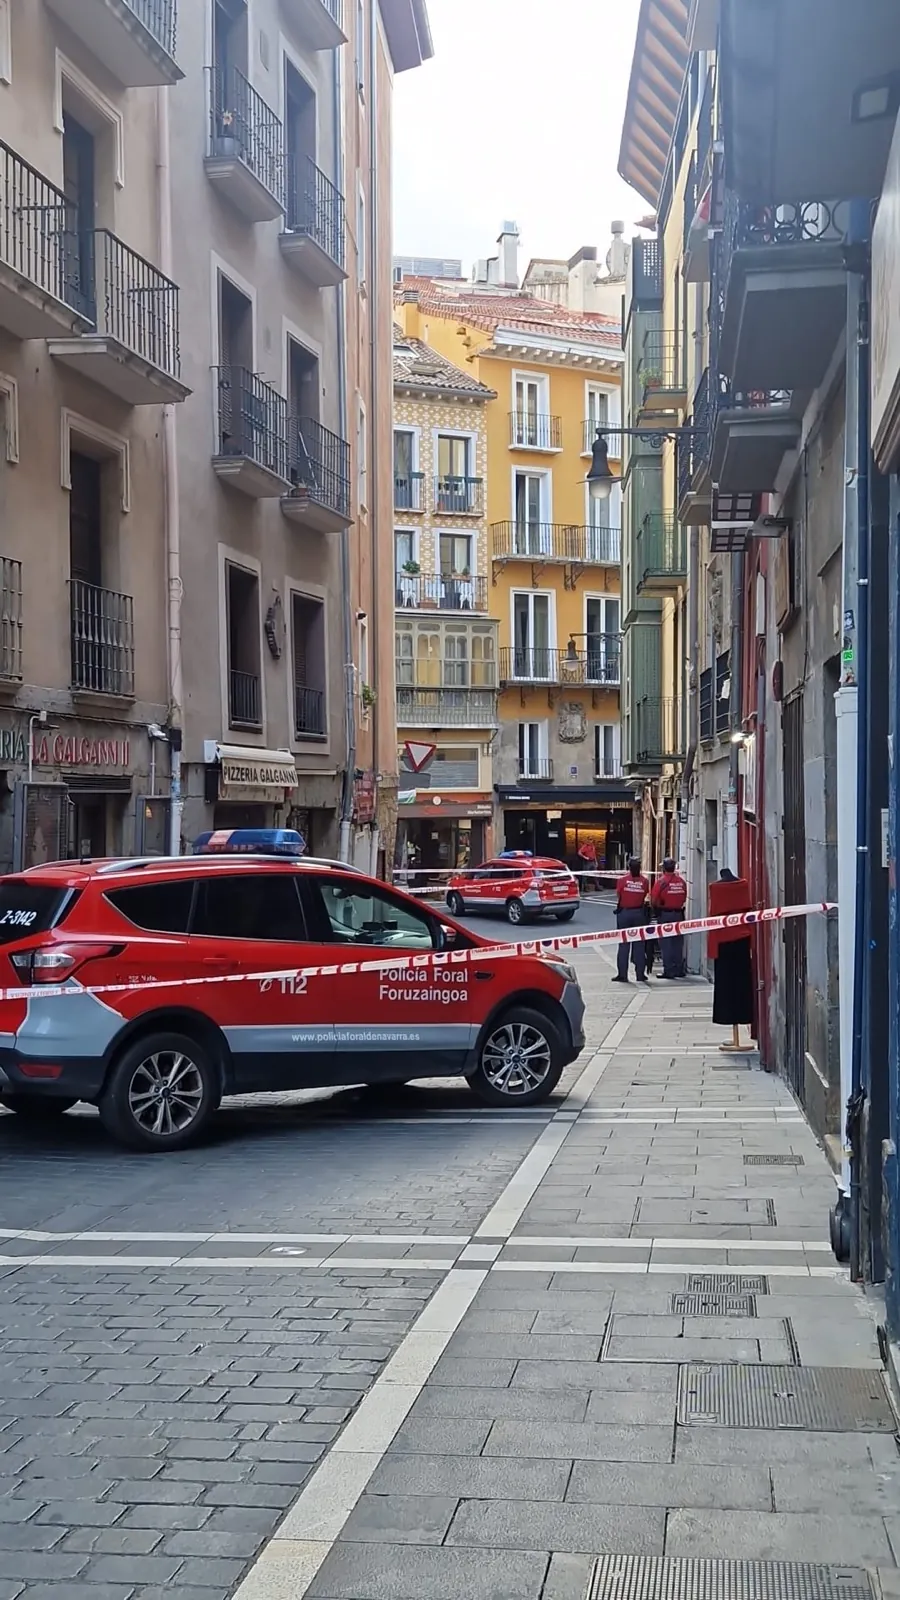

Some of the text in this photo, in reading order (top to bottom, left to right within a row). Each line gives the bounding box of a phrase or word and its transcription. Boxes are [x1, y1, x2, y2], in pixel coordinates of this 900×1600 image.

[223, 766, 258, 782] PIZZERIA
[0, 910, 37, 926] Z-3142
[433, 967, 468, 983] Foral
[279, 975, 308, 994] 112
[379, 985, 468, 1004] Foruzaingoa
[291, 1031, 420, 1043] www.policiaforaldenavarra.es
